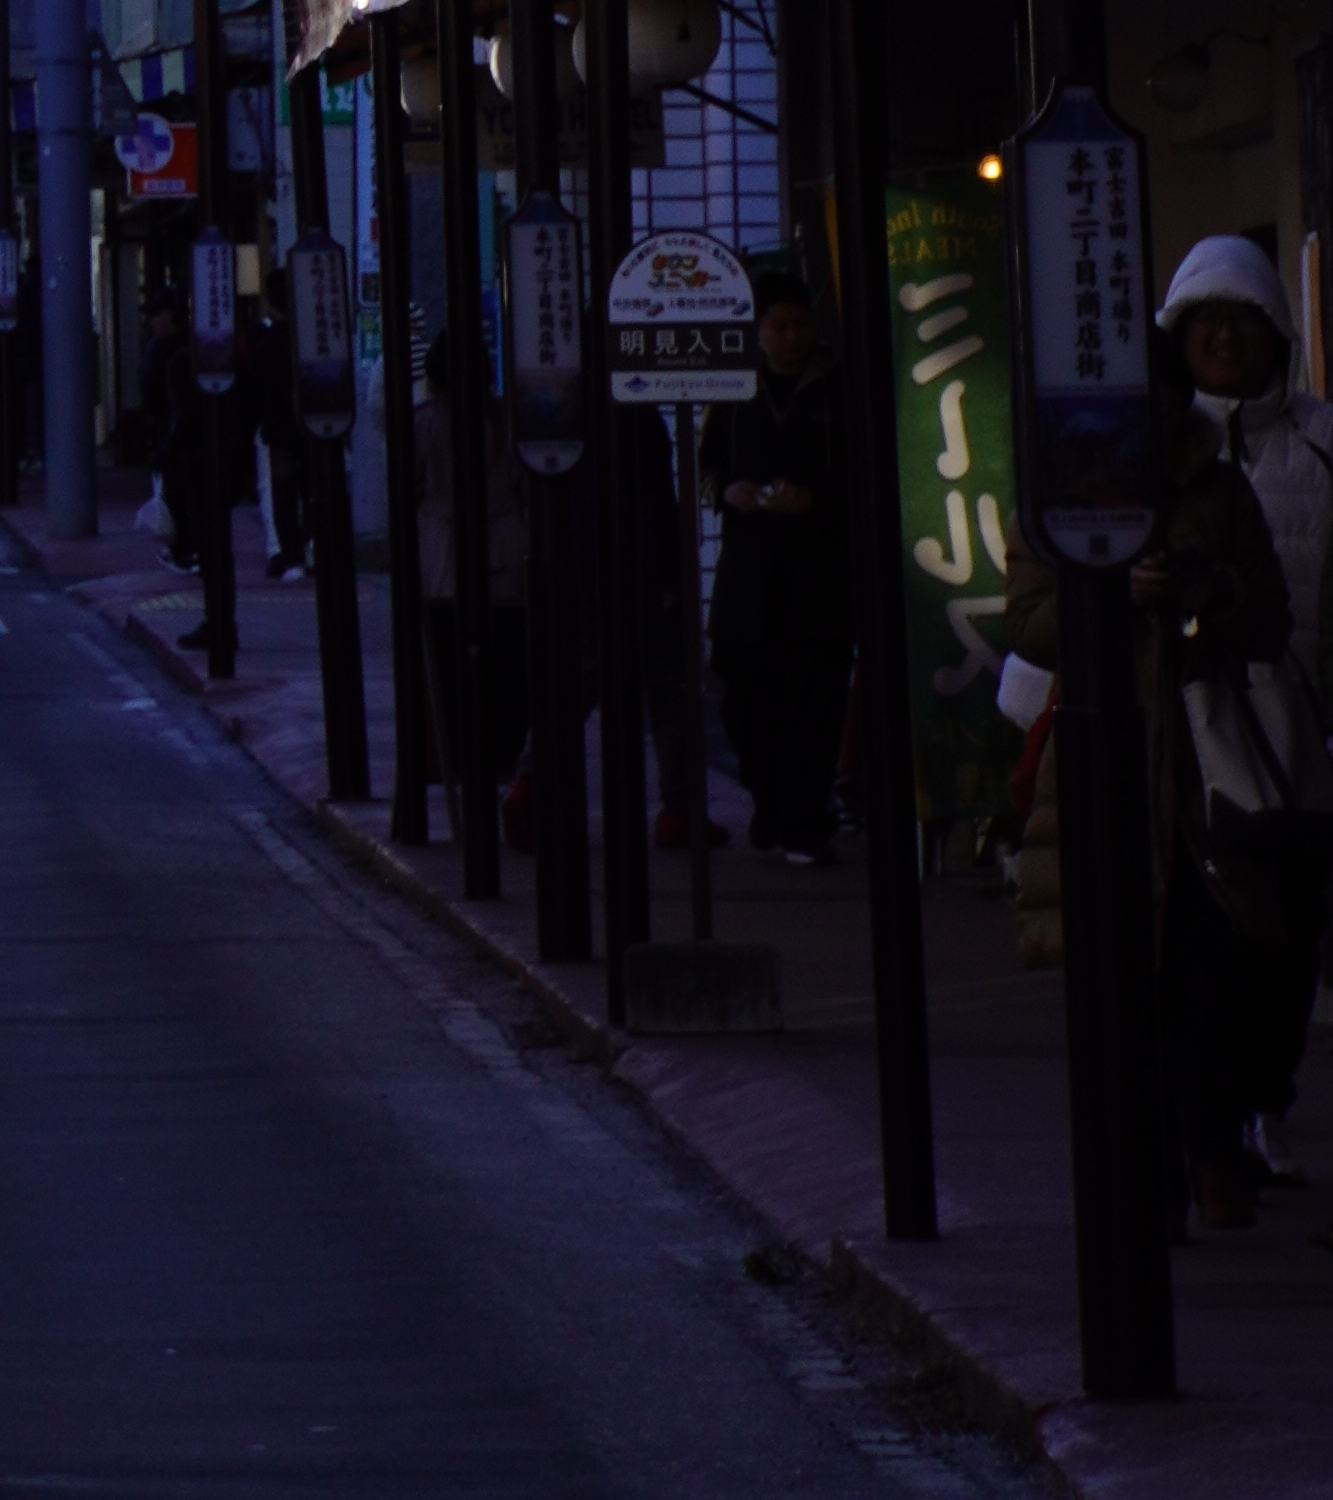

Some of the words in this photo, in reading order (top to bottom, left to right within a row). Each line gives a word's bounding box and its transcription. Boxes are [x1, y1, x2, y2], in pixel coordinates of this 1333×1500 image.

[1104, 147, 1129, 240] 富士吉田
[1065, 147, 1106, 381] 本町二丁目商店街
[619, 329, 745, 357] 明見入口
